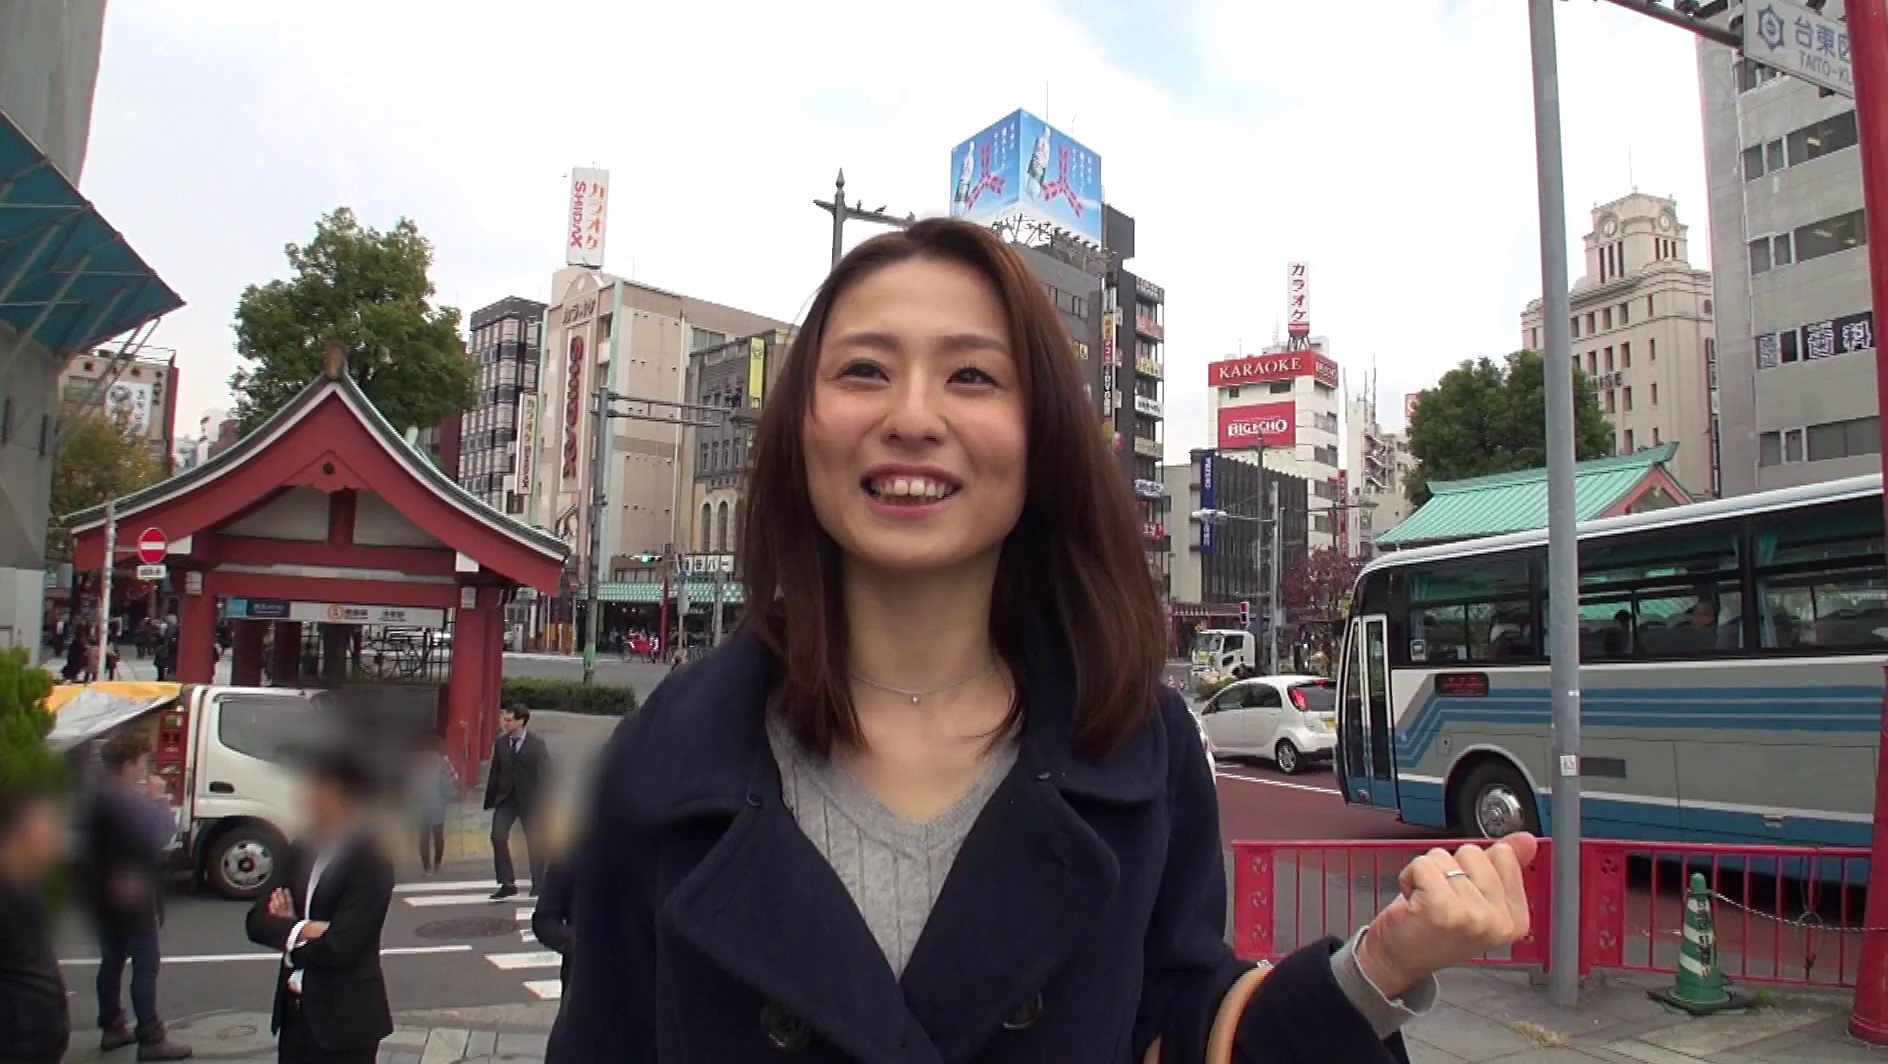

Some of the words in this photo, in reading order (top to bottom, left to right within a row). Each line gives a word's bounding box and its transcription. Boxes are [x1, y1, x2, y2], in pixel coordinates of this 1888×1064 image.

[571, 181, 586, 249] SHIDAX
[586, 182, 605, 250] カラオケ
[1292, 263, 1306, 322] カラオケ
[1219, 357, 1301, 378] KARAOKE
